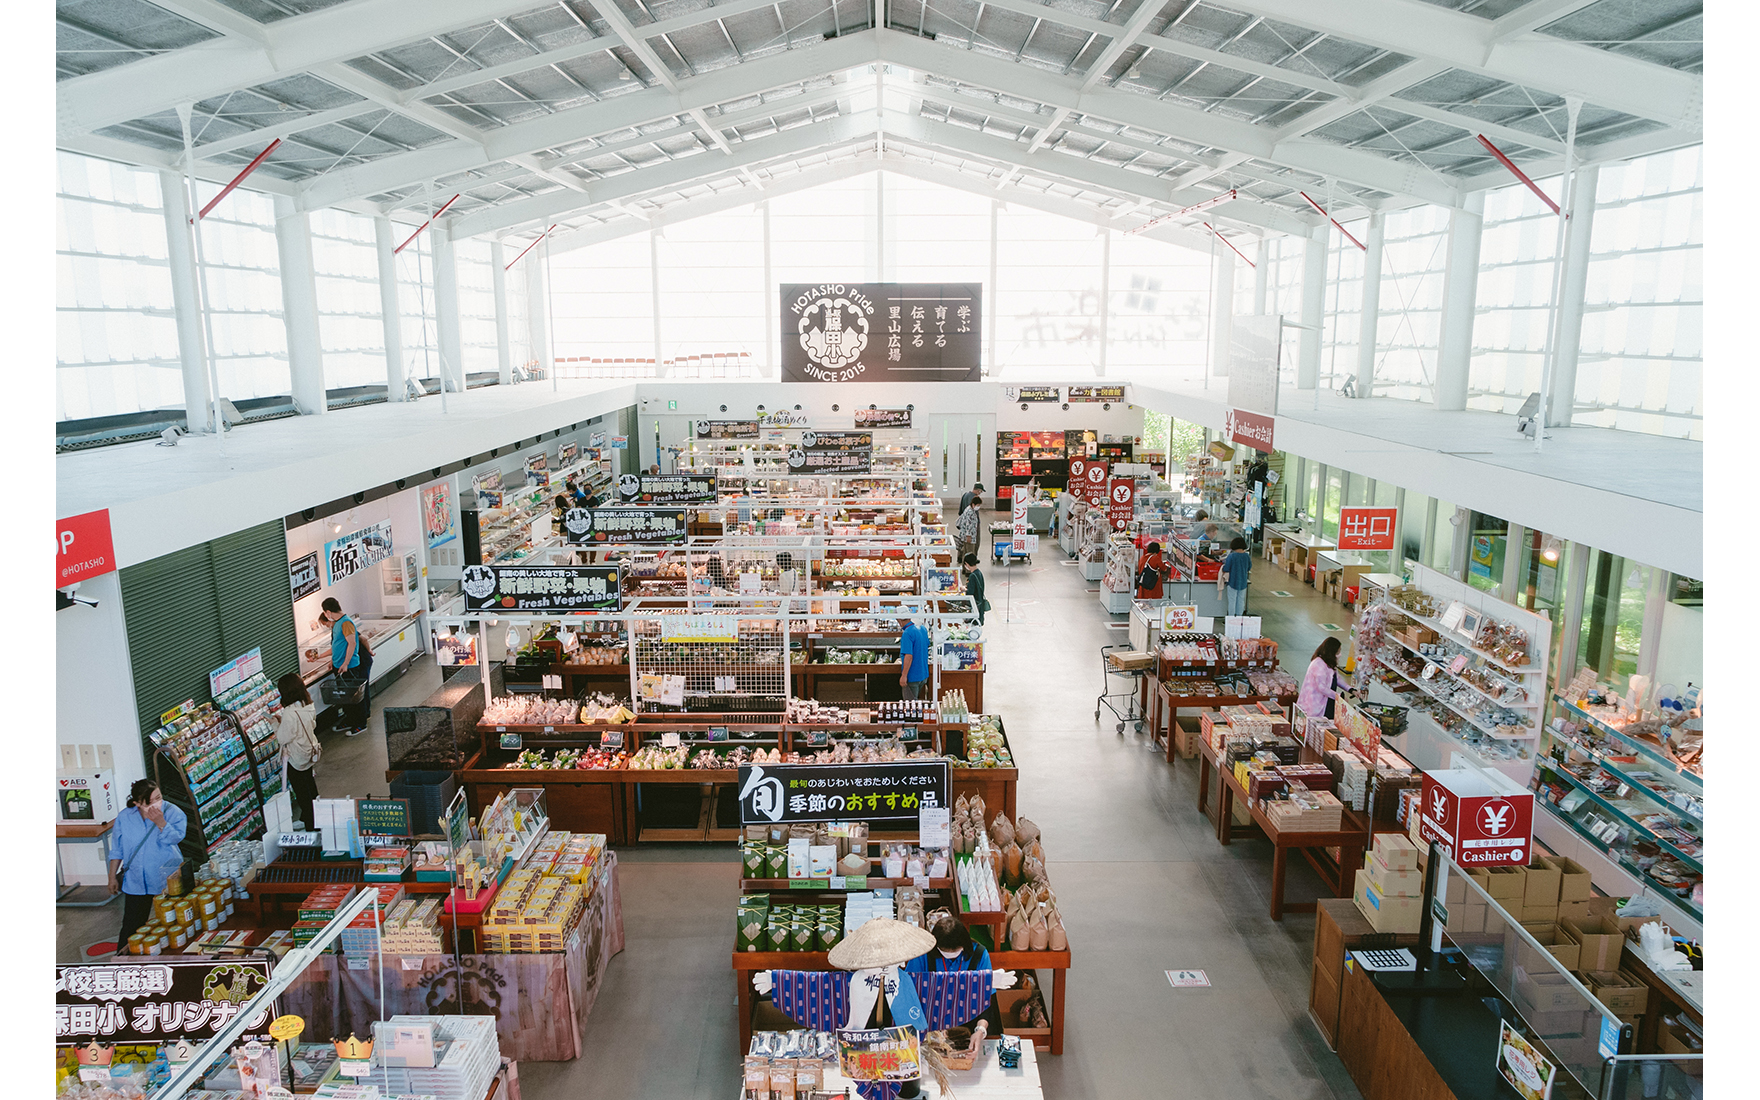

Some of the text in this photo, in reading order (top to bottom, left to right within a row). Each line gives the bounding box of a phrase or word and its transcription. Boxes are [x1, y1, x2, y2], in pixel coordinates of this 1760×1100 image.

[791, 284, 874, 315] HOTASHO Pride
[911, 305, 925, 348] 伝える
[935, 305, 948, 348] 育てる
[957, 305, 971, 333] 学ぶ
[888, 305, 901, 362] 里山広場
[804, 362, 866, 382] SINCE 2015
[1234, 419, 1272, 444] Cashier お会計
[815, 464, 870, 474] selected souvenirs
[675, 490, 716, 499] Vegetables
[1014, 492, 1027, 551] レジ先頭
[1345, 515, 1391, 538] 出口
[608, 528, 686, 542] Fresh Vegetables
[62, 556, 105, 578] @HOTASHO
[330, 543, 360, 582] 鯨
[360, 546, 391, 570] KUJIRA
[519, 591, 619, 608] Fresh Vegetables
[1171, 617, 1189, 625] お菓子
[739, 766, 784, 821] 旬
[789, 776, 937, 789] 最旬のあじわいをおためしください
[789, 791, 939, 814] 季節のおすすめ品
[1474, 839, 1515, 847] 花専用レジ
[1462, 850, 1509, 862] Cashier
[68, 969, 166, 993] 校長厳選
[417, 957, 507, 988] HOTASO Pride
[842, 1032, 879, 1041] 令和4年
[89, 1049, 98, 1062] 3
[178, 1046, 188, 1058] 2
[350, 1043, 356, 1056] 1
[858, 1052, 899, 1070] 新米
